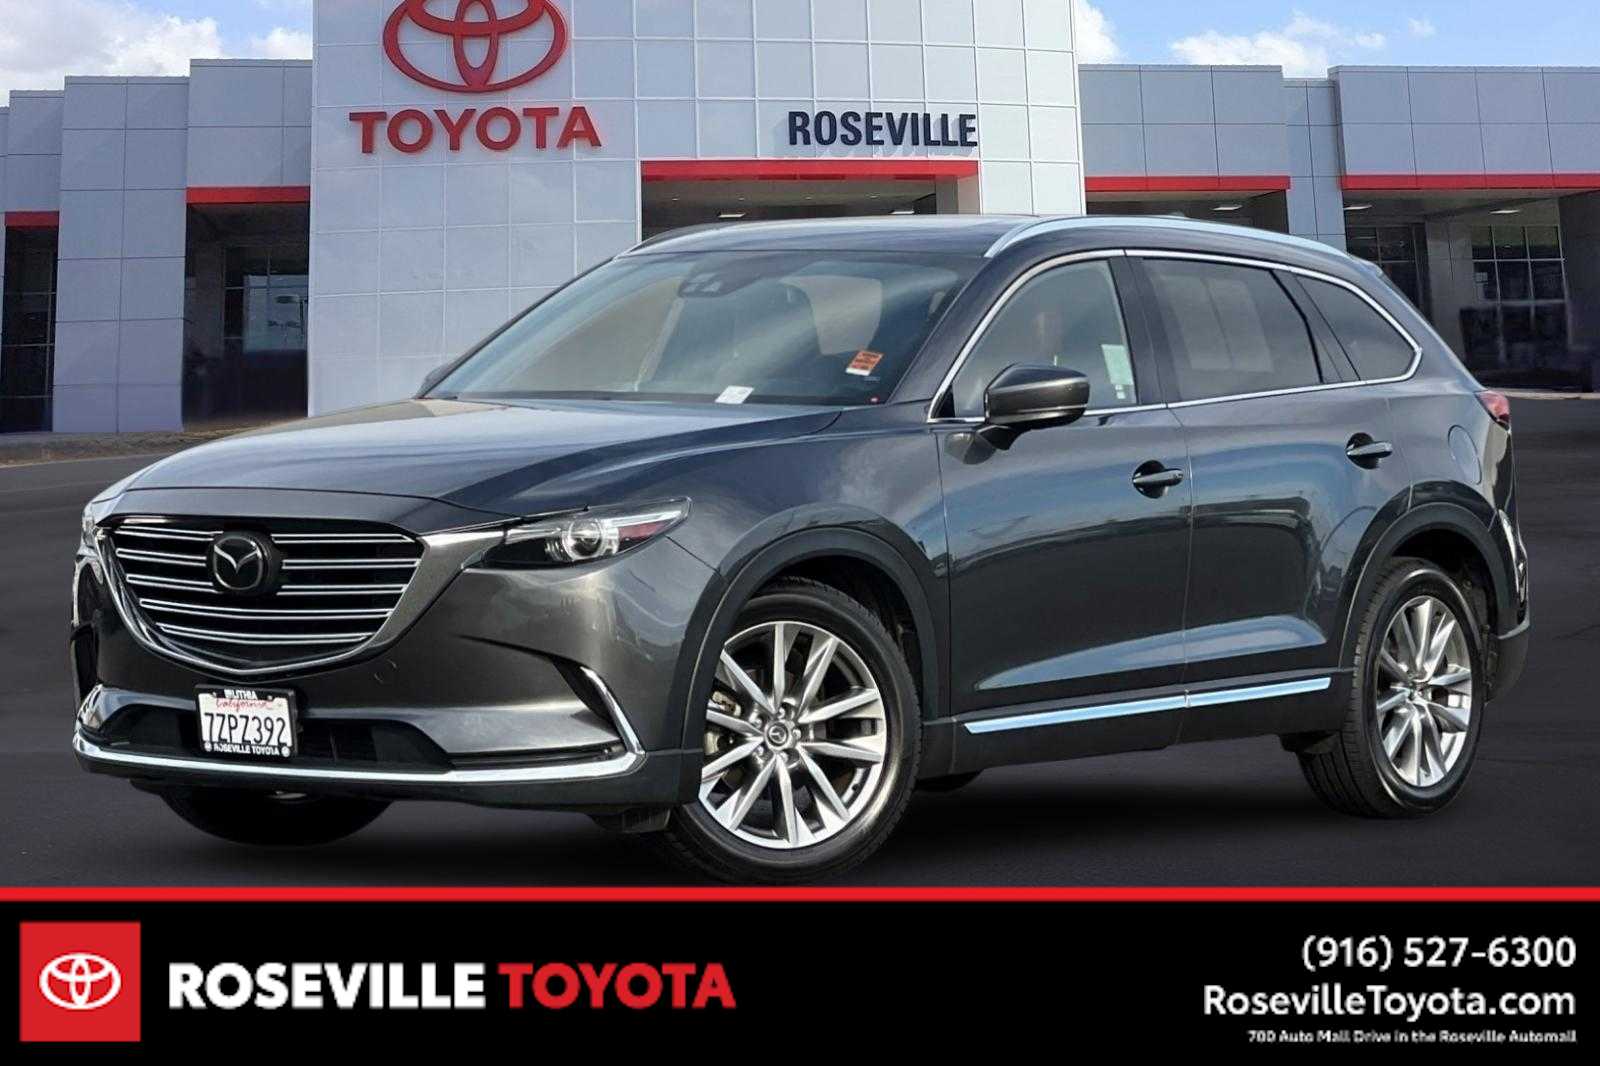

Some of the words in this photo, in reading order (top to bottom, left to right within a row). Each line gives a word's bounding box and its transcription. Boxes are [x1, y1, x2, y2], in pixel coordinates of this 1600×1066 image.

[349, 106, 602, 154] TOYOTA
[788, 110, 978, 148] ROSEVILLE
[204, 712, 288, 747] 7ZPZ392
[213, 743, 251, 754] ROSEVILLE
[251, 745, 280, 756] TOYOTA
